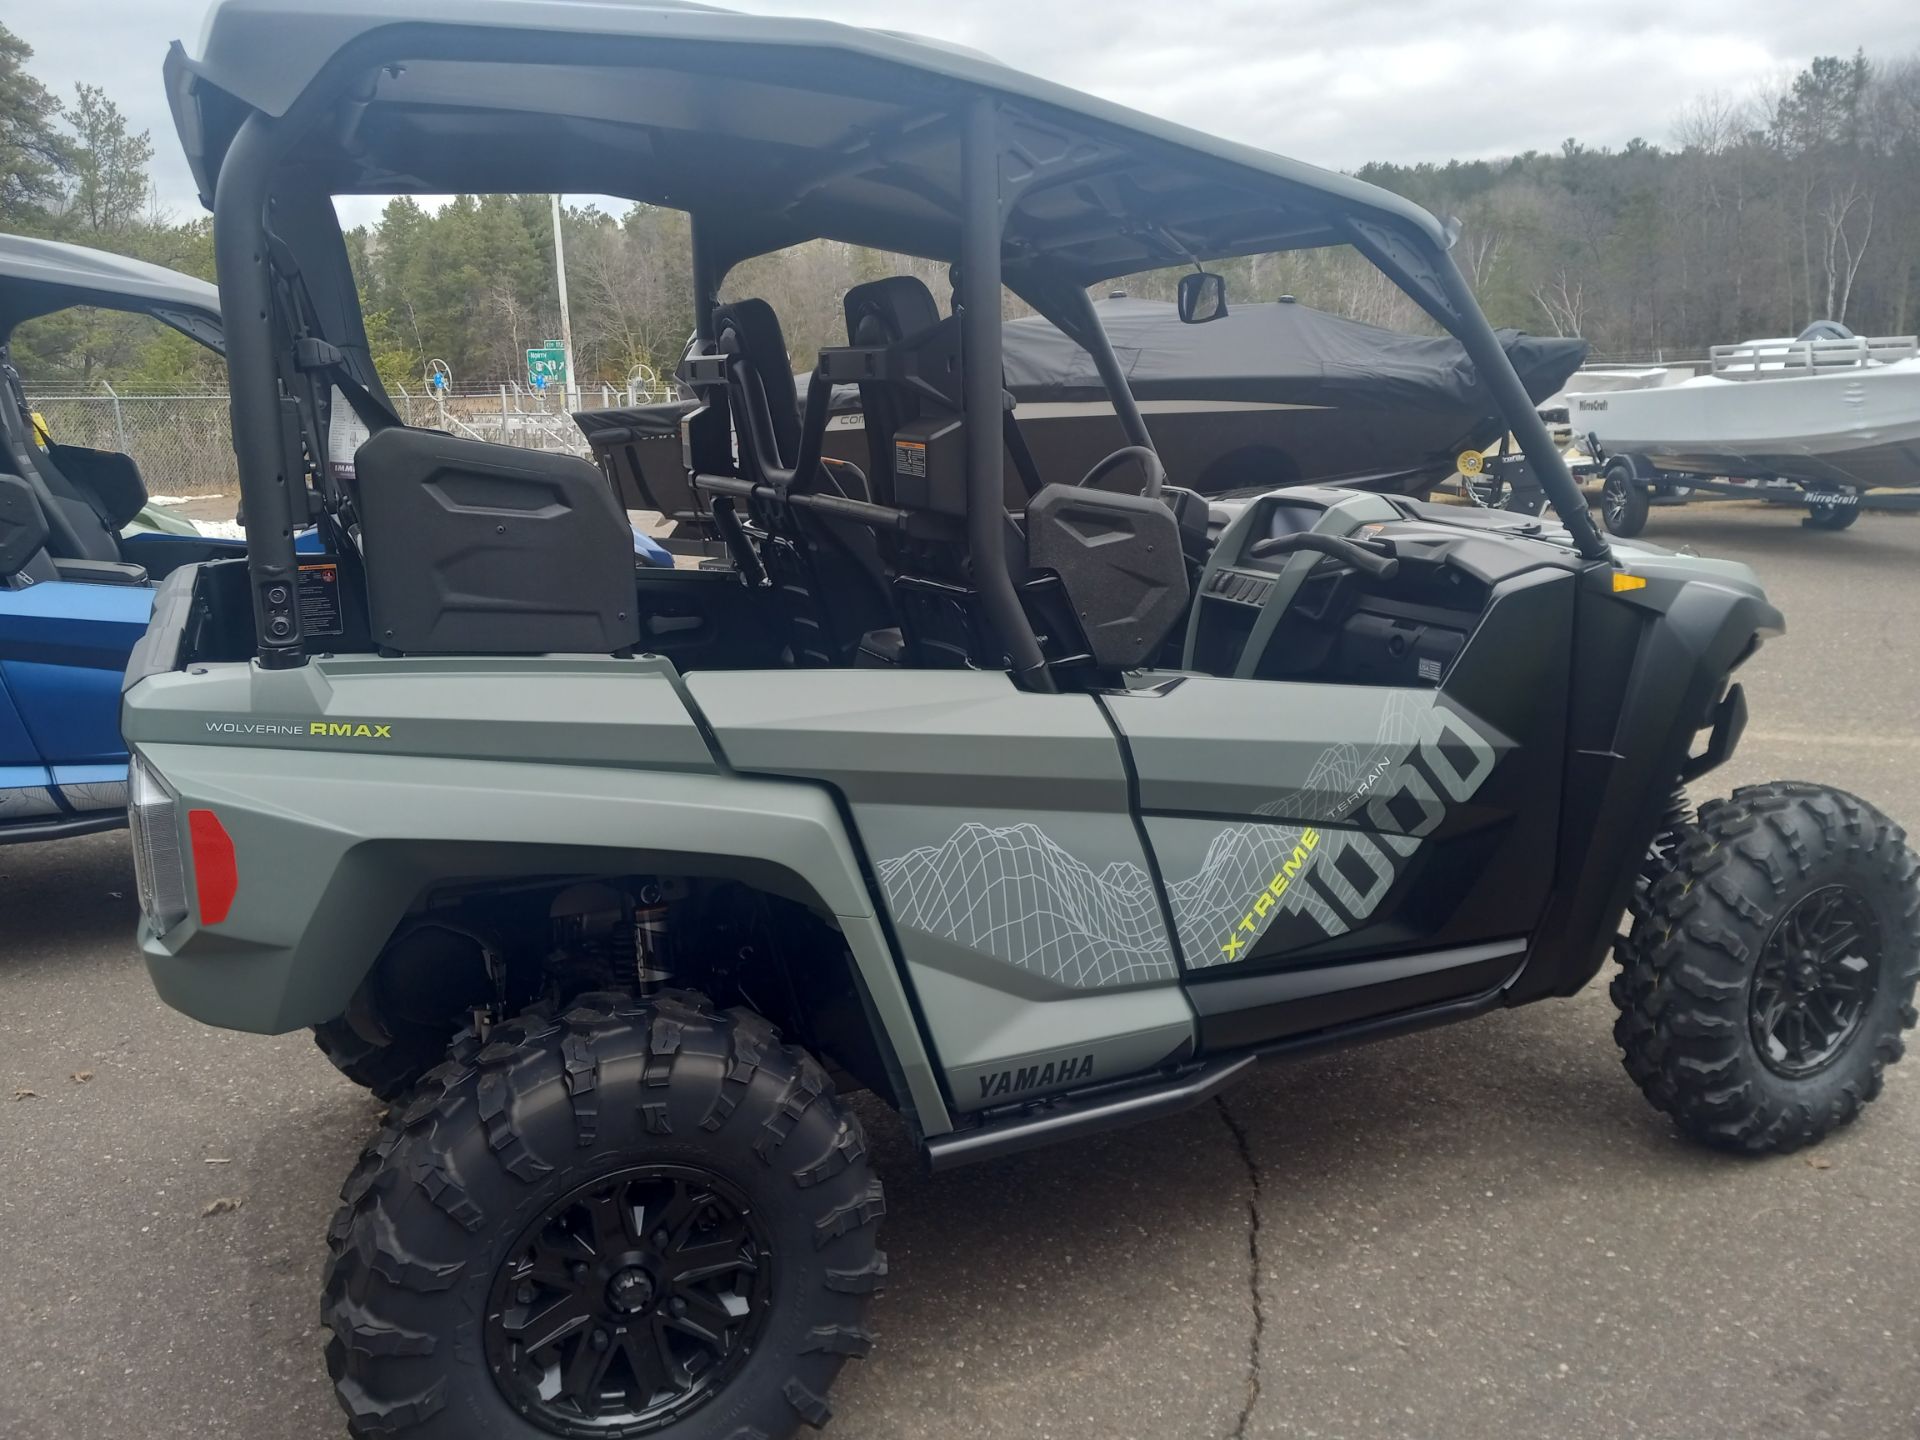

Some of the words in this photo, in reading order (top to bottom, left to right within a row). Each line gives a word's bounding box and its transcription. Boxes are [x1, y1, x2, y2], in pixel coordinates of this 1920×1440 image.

[1580, 399, 1608, 411] MirroCraft
[1803, 492, 1859, 504] MirroCraft
[205, 722, 304, 736] WOLVERINE
[309, 722, 393, 738] RMAX
[1283, 705, 1496, 938] 1000
[1221, 826, 1321, 961] XTREME
[1326, 756, 1391, 818] TERRAIN
[979, 1054, 1095, 1099] YAMAHA
